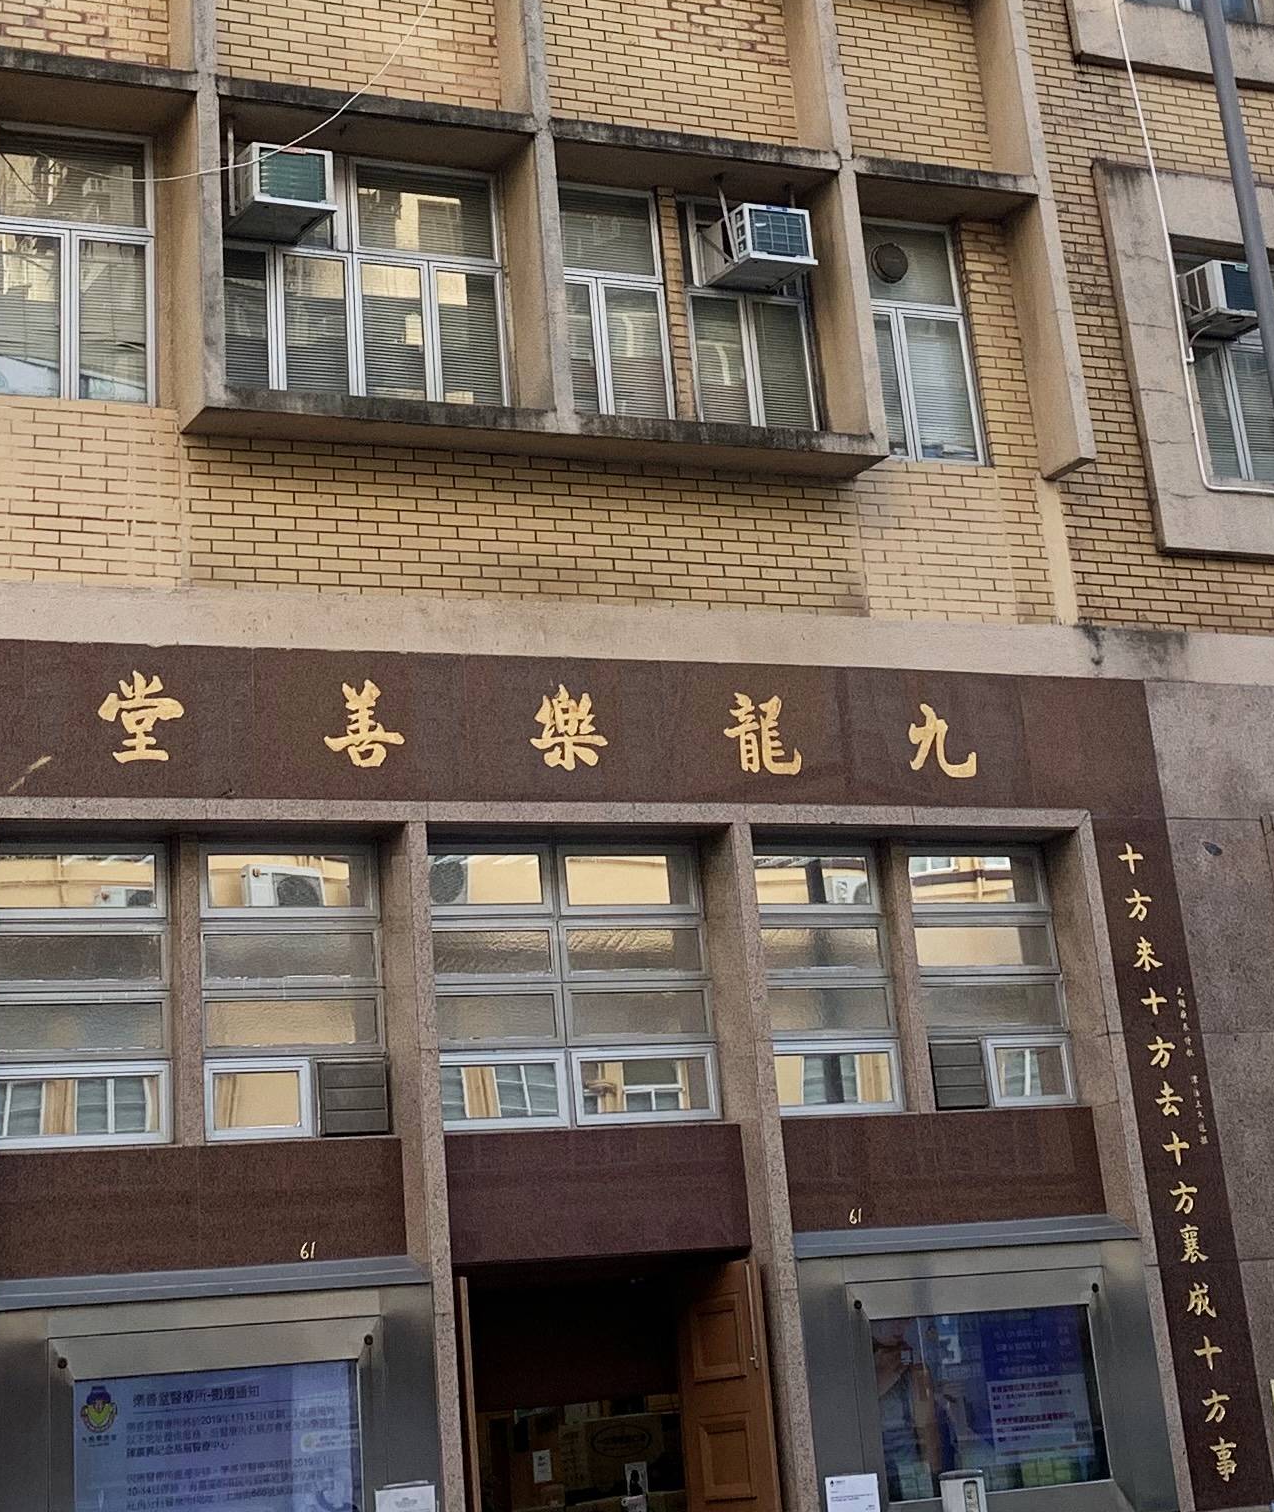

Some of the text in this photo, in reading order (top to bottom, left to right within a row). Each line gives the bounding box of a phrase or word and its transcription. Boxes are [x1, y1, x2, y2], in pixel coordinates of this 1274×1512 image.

[97, 671, 977, 779] 九龍樂善堂
[848, 1207, 863, 1226] 61
[299, 1240, 317, 1261] 61
